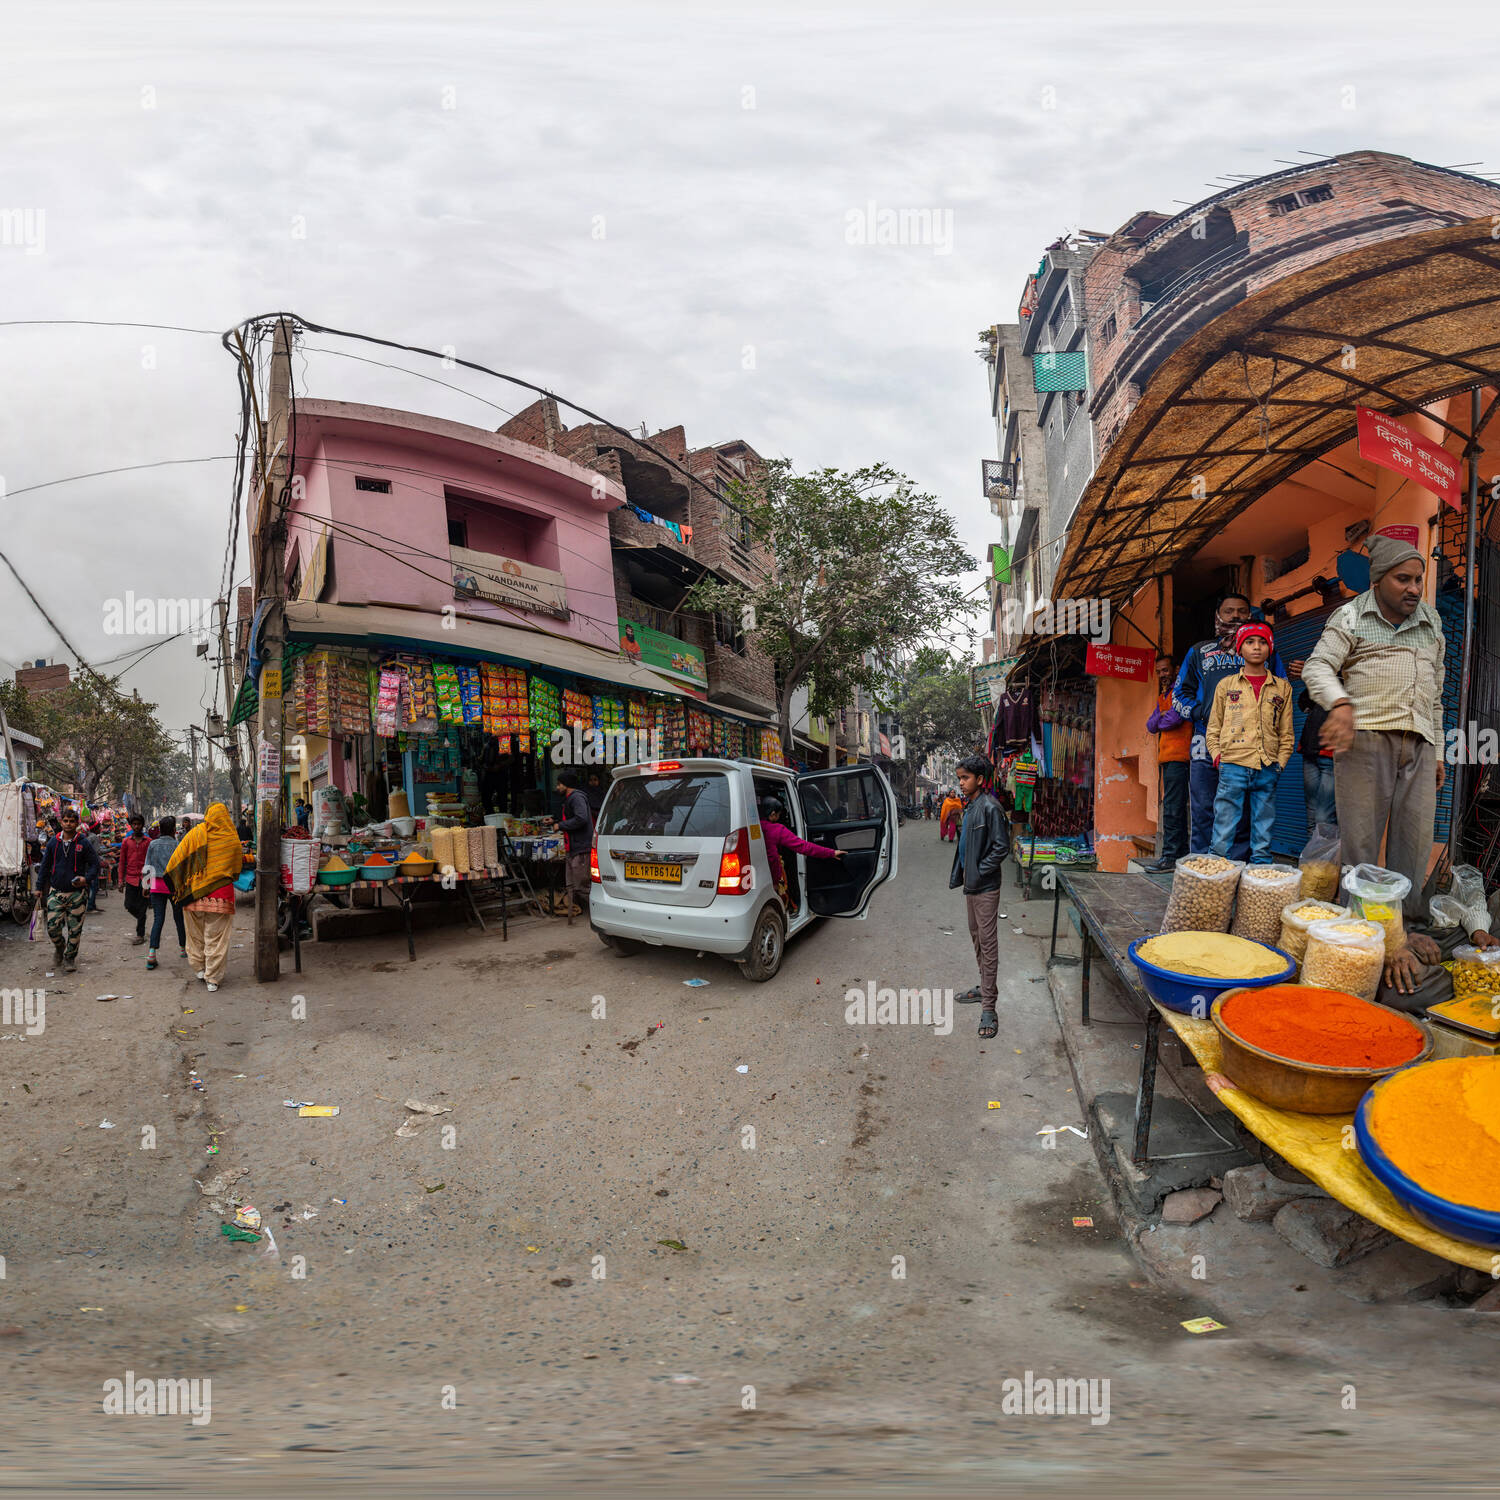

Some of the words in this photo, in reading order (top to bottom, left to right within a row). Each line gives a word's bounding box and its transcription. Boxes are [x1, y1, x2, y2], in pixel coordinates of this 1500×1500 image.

[1374, 415, 1396, 427] airtel
[1396, 425, 1408, 434] 4G
[1374, 424, 1413, 453] दिल्ली
[1417, 447, 1431, 463] का
[1433, 457, 1455, 481] सबसे
[1418, 461, 1449, 489] नेटवर्क
[488, 573, 539, 592] VANDANAM
[535, 605, 555, 615] STORE
[1214, 654, 1246, 666] YAM
[630, 865, 680, 878] DL1RTB6144
